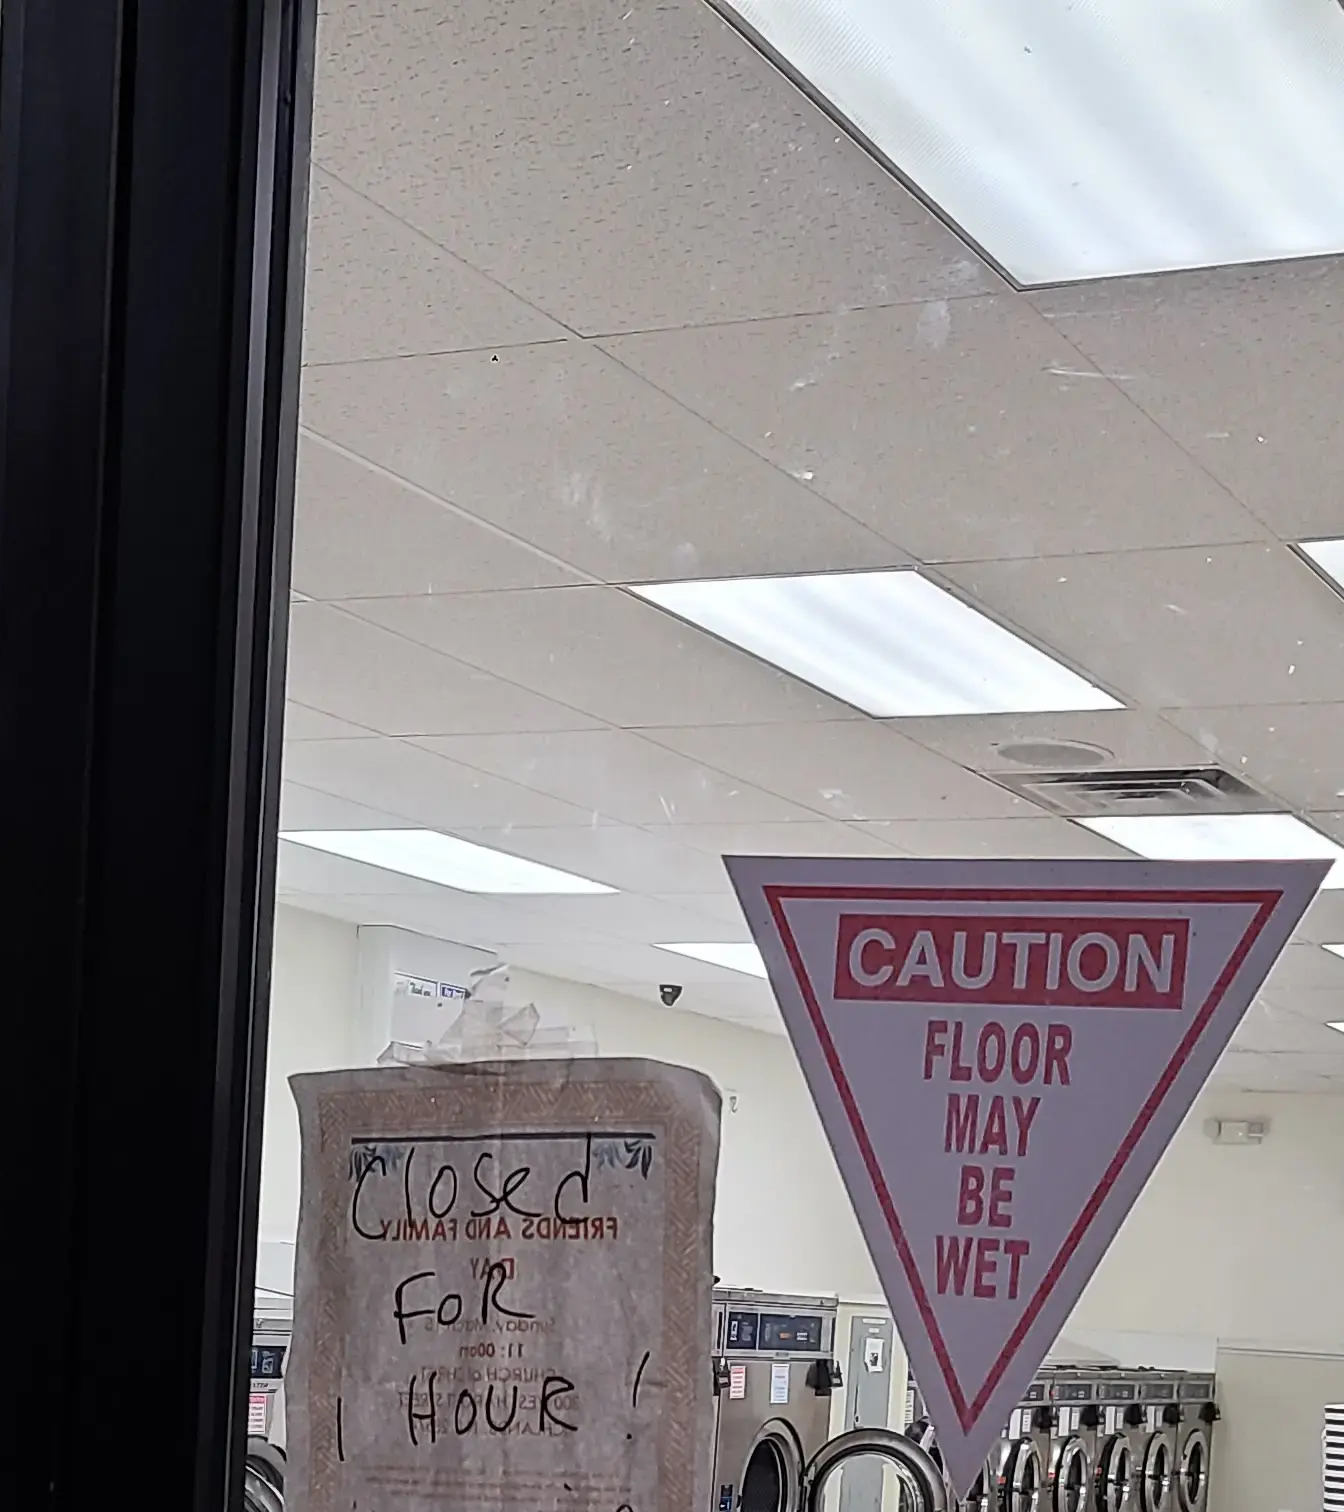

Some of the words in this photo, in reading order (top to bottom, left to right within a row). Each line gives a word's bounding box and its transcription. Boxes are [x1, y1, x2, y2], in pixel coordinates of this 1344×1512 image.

[848, 927, 1175, 993] CAUTION
[923, 1019, 1073, 1086] FLOOR
[944, 1093, 1041, 1157] MAY
[957, 1164, 1015, 1228] BE
[935, 1235, 1030, 1300] WET
[408, 1371, 578, 1446] HOUR
